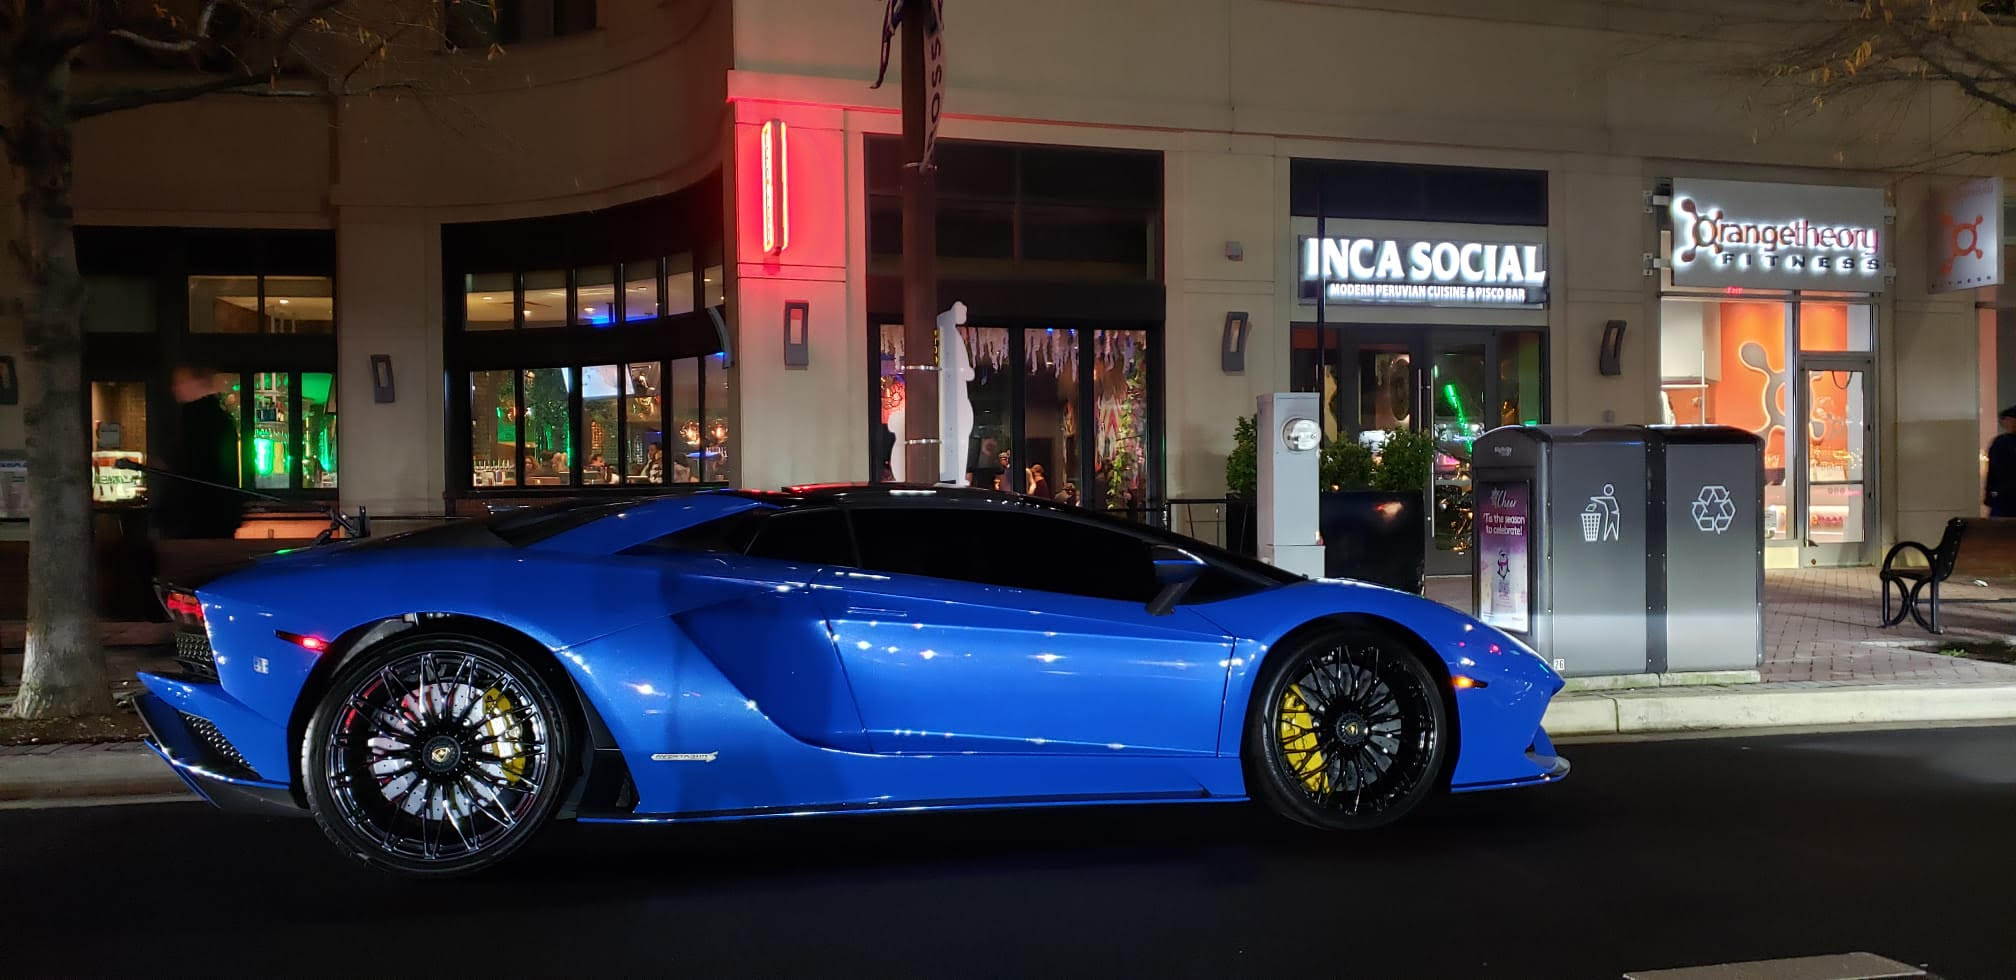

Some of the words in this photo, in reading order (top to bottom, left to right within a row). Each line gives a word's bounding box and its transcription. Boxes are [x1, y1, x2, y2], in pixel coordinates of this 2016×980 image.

[1305, 237, 1404, 280] INCA
[1410, 241, 1546, 282] SOCIAL
[1721, 252, 1880, 270] FITNESS
[1330, 283, 1375, 297] MODERN
[1376, 284, 1426, 298] PERUVIAN
[1427, 285, 1466, 299] CUISINE
[1466, 286, 1475, 299] &
[1475, 287, 1505, 300] PISCO
[1505, 287, 1526, 301] BAR
[1493, 513, 1504, 524] the
[1504, 515, 1526, 525] season
[1485, 525, 1493, 534] to
